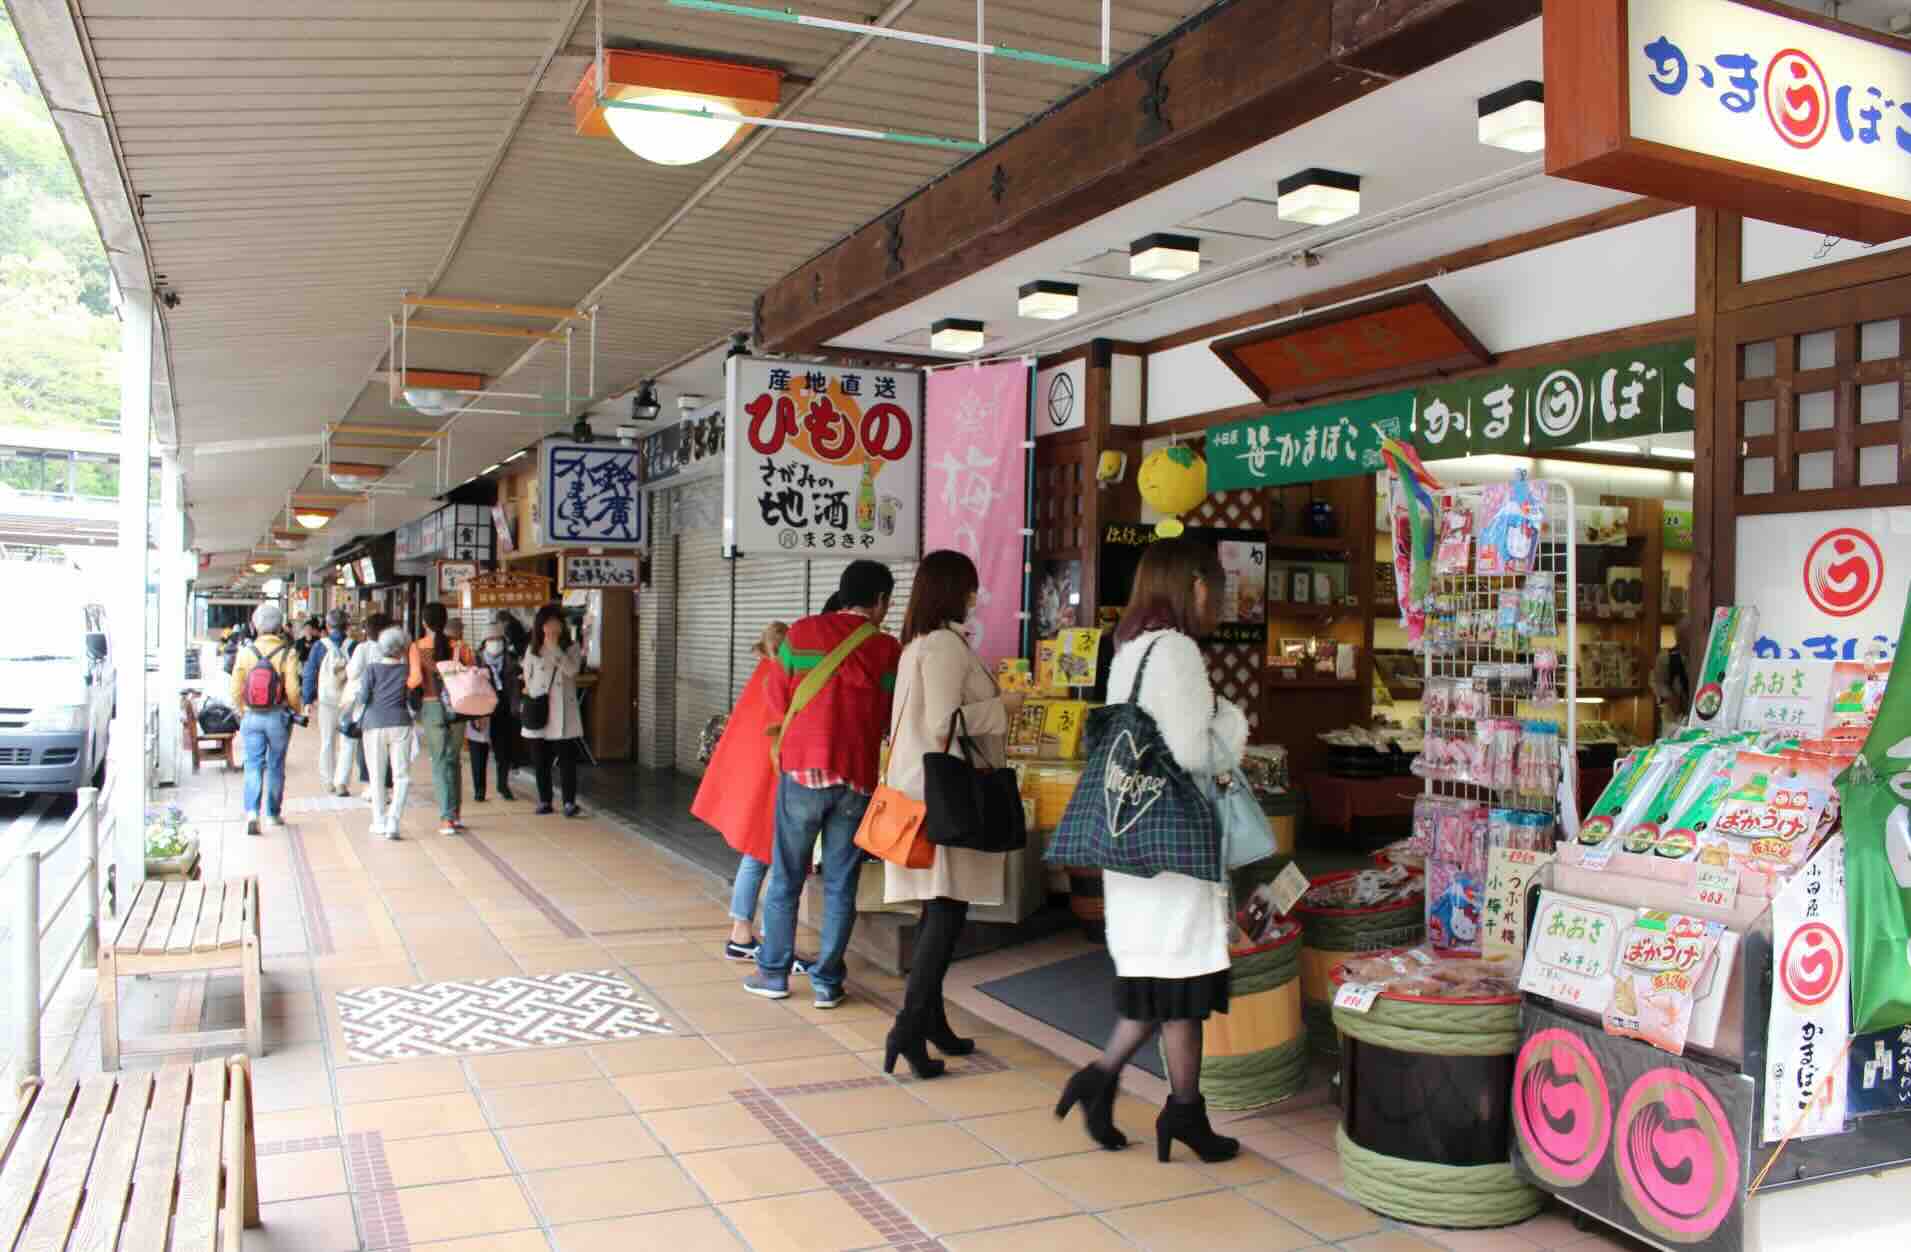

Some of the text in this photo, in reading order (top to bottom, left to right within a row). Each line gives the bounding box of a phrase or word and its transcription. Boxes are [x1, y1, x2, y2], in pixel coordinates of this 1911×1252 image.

[769, 369, 896, 399] 産地直送
[744, 393, 912, 460] ひもの
[1236, 416, 1359, 477] 笹かまぼこ
[760, 458, 834, 488] さがみの
[758, 487, 849, 530] 地酒
[803, 532, 874, 549] まるきや
[1749, 669, 1805, 696] あおさ
[1713, 806, 1806, 840] ばかうけ
[1806, 863, 1821, 917] 小田原
[1547, 911, 1605, 944] あおさ
[1624, 936, 1699, 969] ばかうけ
